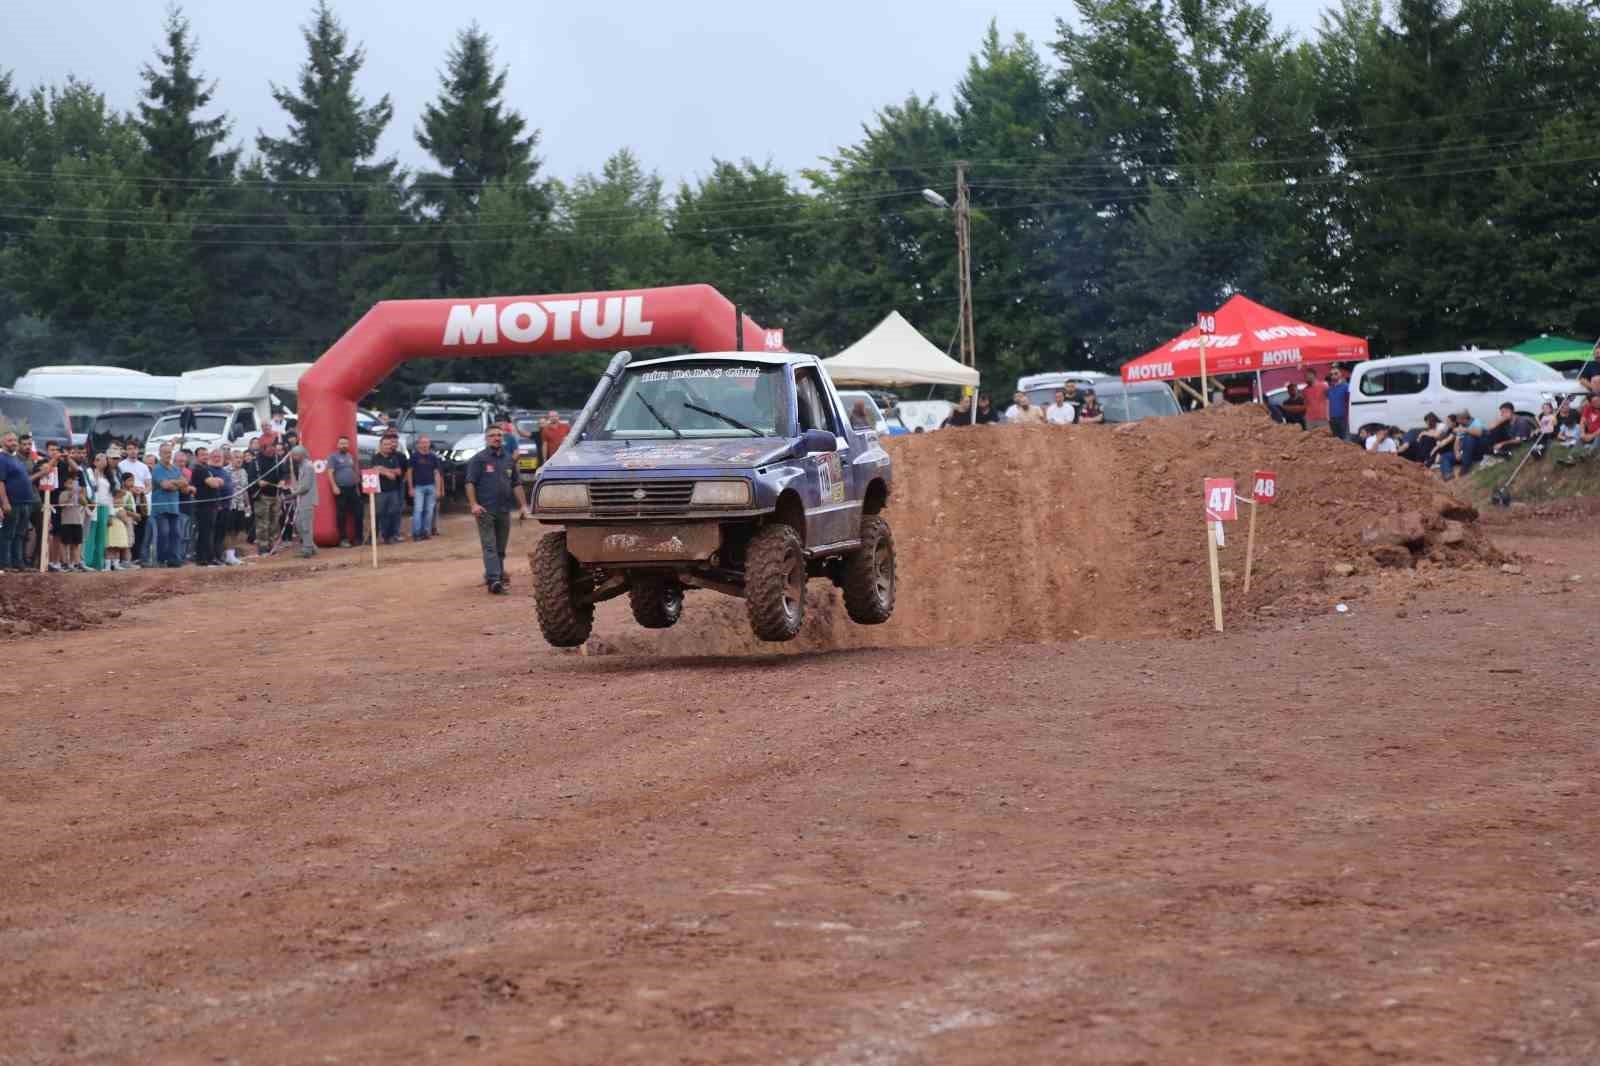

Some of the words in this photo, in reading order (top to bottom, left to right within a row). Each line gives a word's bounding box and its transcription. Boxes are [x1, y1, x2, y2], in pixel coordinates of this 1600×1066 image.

[442, 296, 654, 346] MOTUL
[1201, 316, 1215, 332] 49
[1253, 326, 1317, 341] MOTUL
[1262, 347, 1302, 366] MOTUL
[1127, 362, 1174, 380] MOTUL
[1255, 478, 1275, 497] 48
[1209, 487, 1232, 512] 47
